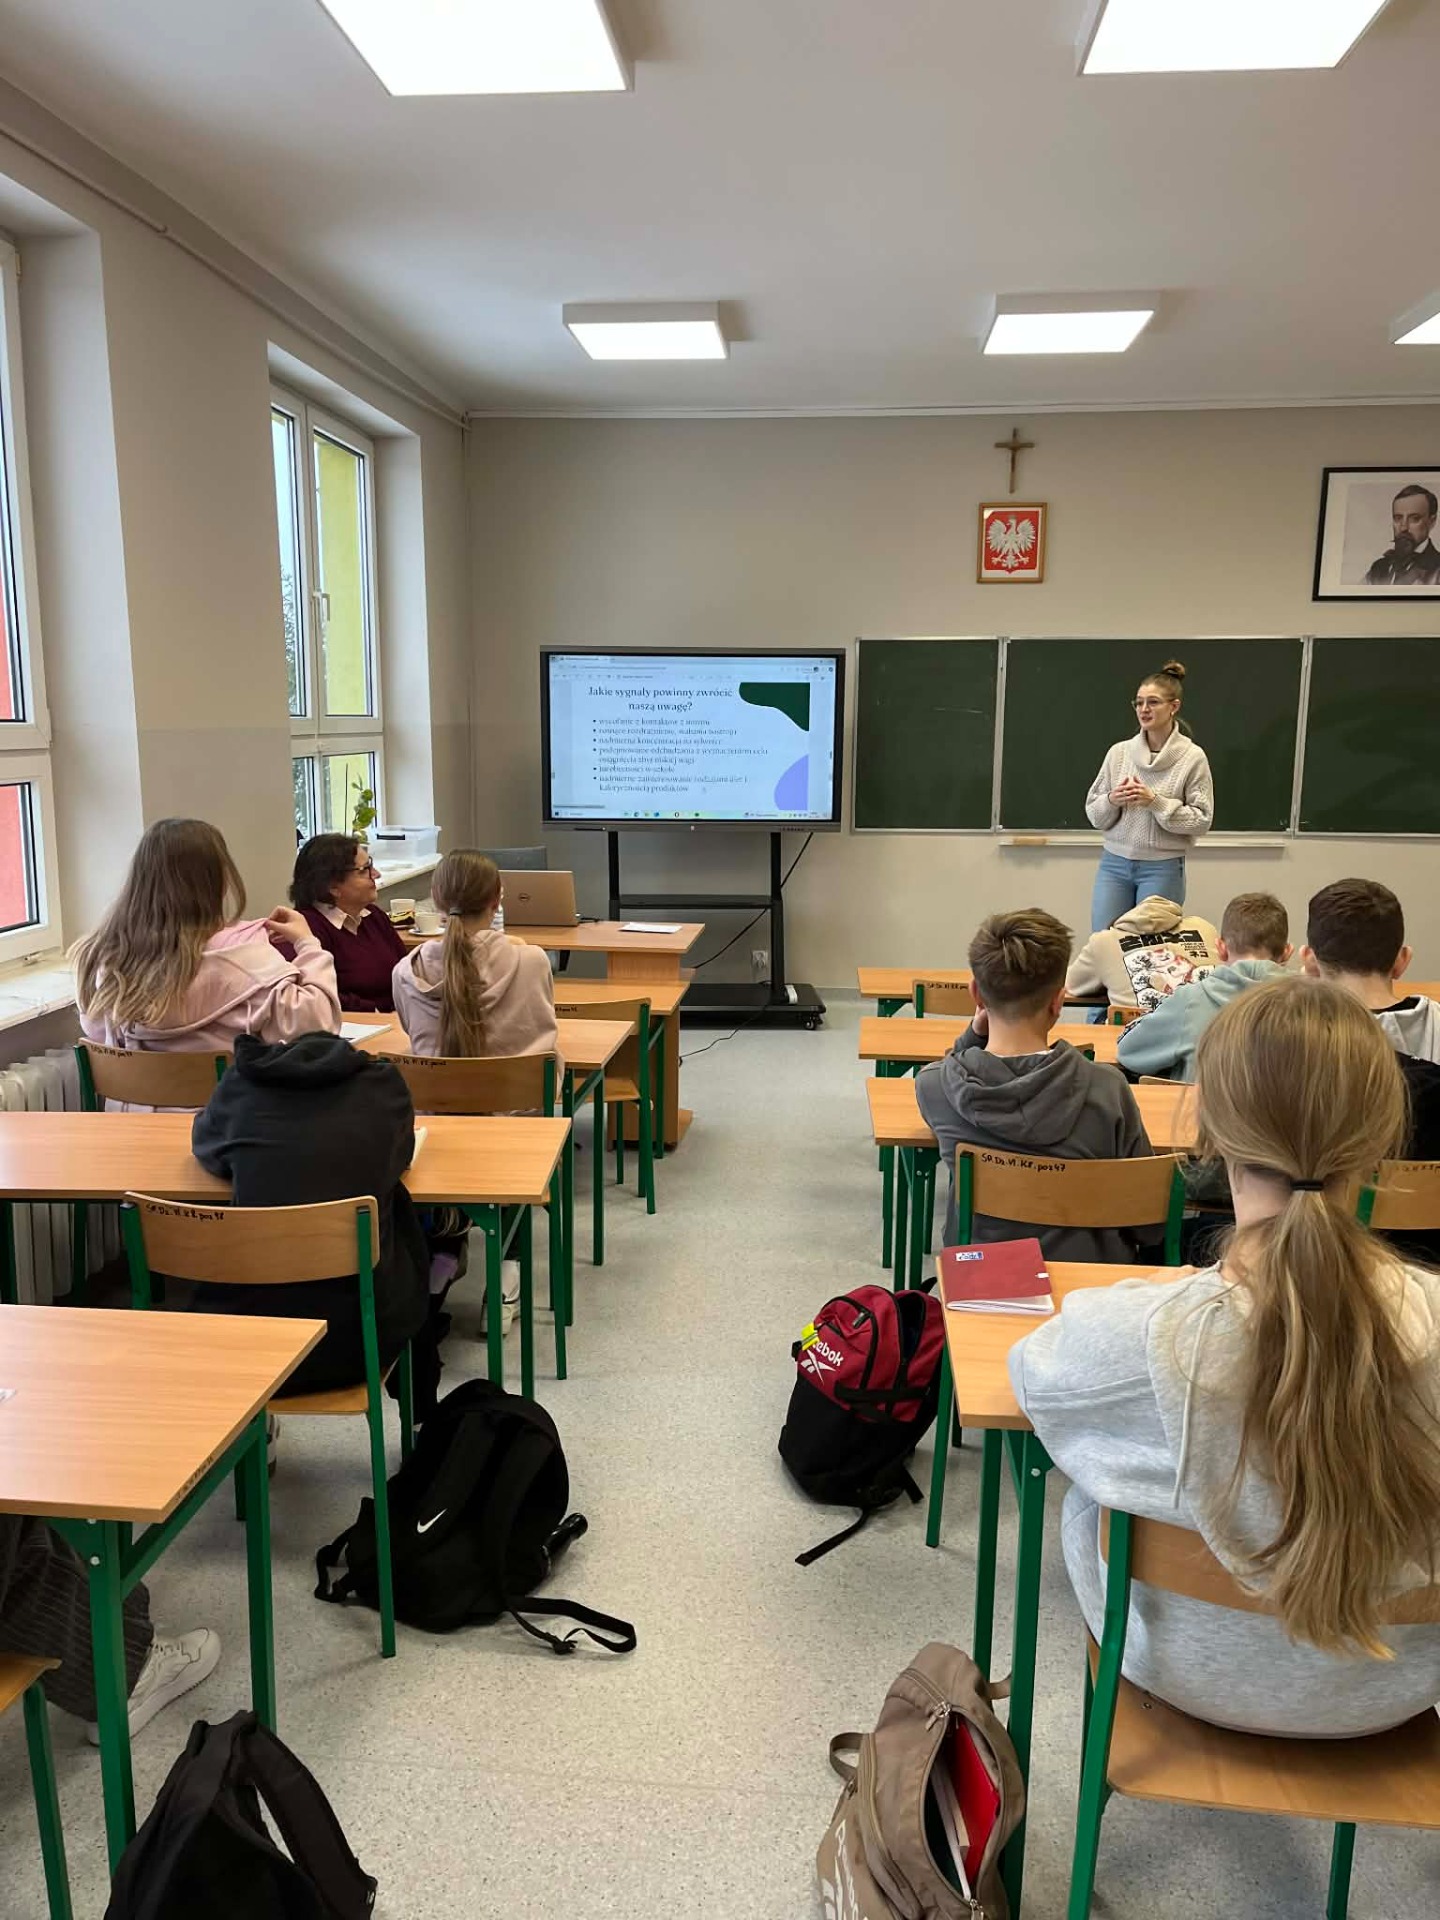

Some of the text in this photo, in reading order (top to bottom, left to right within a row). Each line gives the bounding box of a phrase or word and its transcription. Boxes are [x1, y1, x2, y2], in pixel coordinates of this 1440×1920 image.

[588, 687, 613, 696] Jakie
[653, 688, 693, 699] powinny
[812, 1341, 844, 1367] ebok
